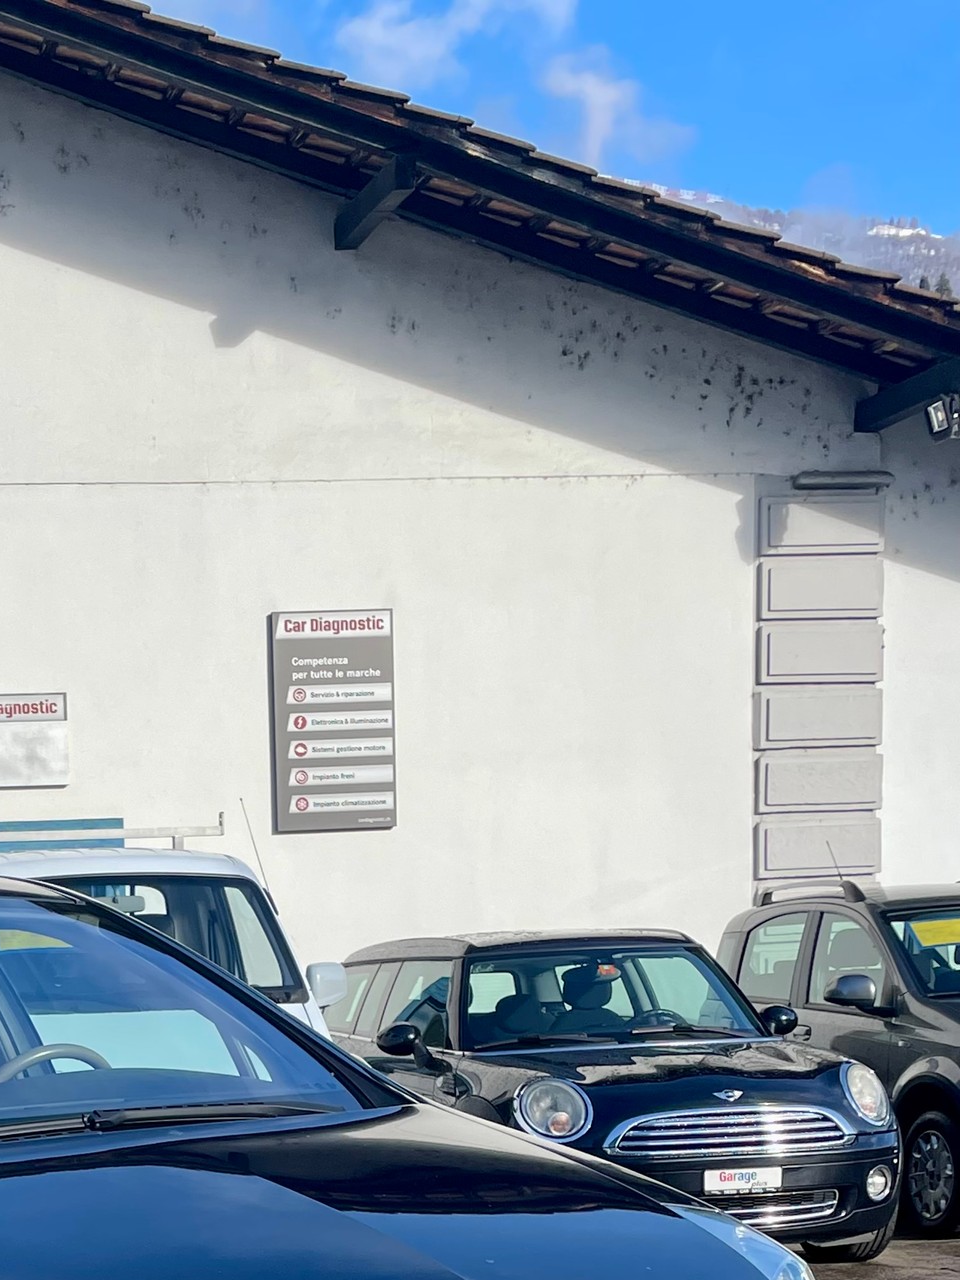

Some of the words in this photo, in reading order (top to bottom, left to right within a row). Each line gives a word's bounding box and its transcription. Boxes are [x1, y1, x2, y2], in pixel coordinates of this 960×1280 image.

[284, 619, 307, 632] Car
[310, 615, 384, 635] Diagnostic
[291, 657, 348, 667] Competenza
[292, 672, 308, 681] per
[310, 670, 333, 679] tutte
[335, 669, 344, 678] le
[346, 668, 381, 677] marche
[310, 691, 335, 699] Servizio
[341, 690, 375, 698] riparazione
[336, 745, 362, 753] gestione
[312, 773, 339, 781] Impianto
[719, 1171, 757, 1183] Garage
